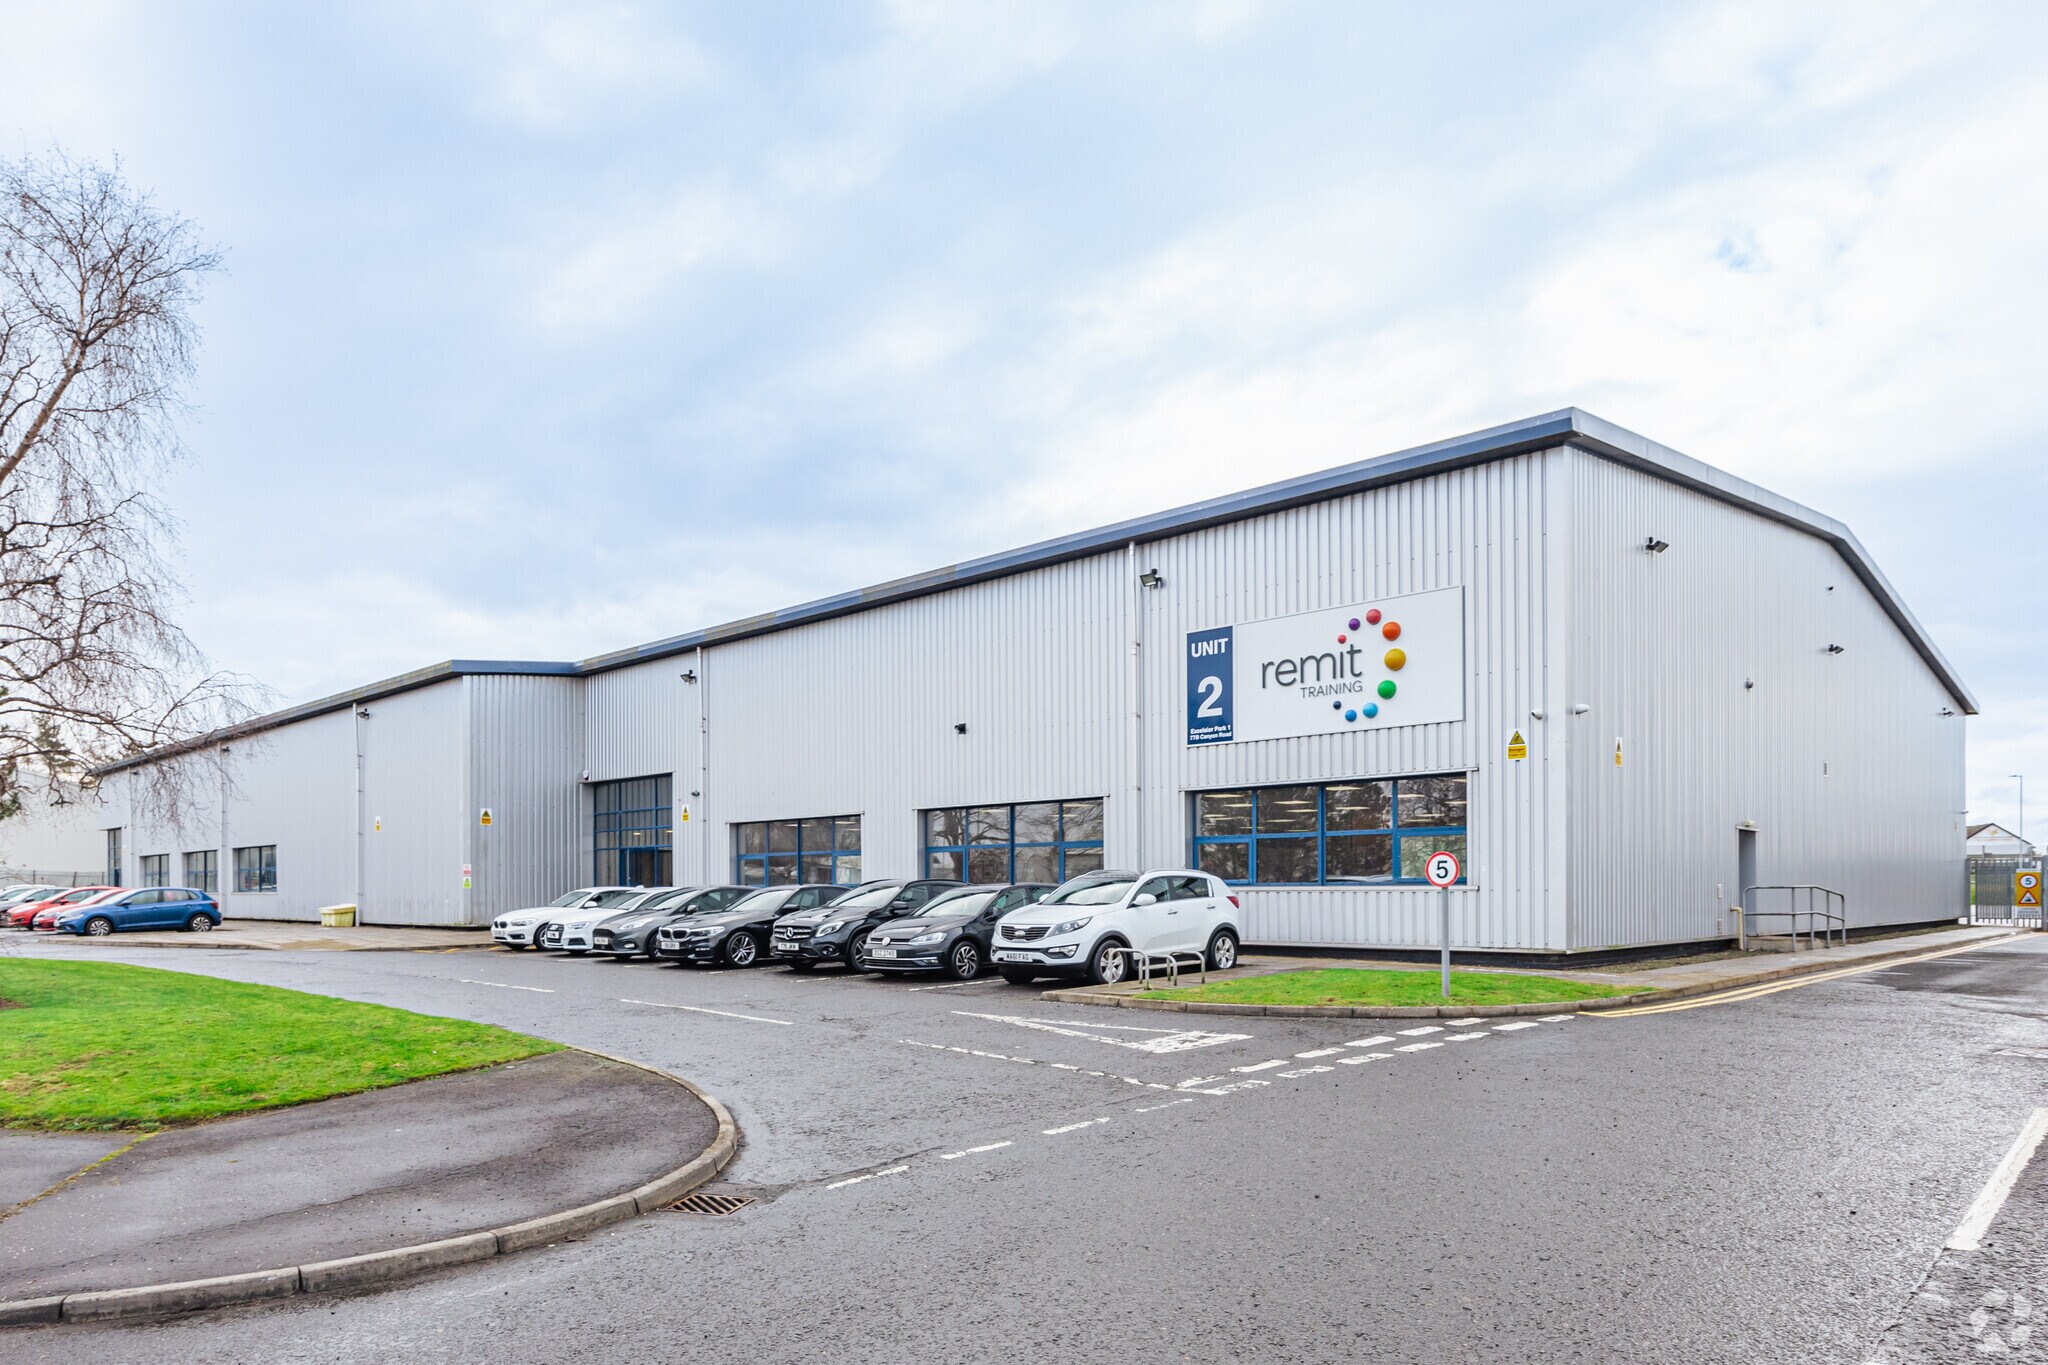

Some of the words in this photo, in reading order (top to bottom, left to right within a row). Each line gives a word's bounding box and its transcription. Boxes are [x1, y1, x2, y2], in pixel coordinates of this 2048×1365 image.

[1191, 638, 1228, 657] UNIT
[1262, 643, 1362, 689] remit
[1197, 675, 1222, 718] 2
[1300, 680, 1363, 699] TRAINING
[1436, 860, 1448, 879] 5
[2025, 877, 2032, 885] 5
